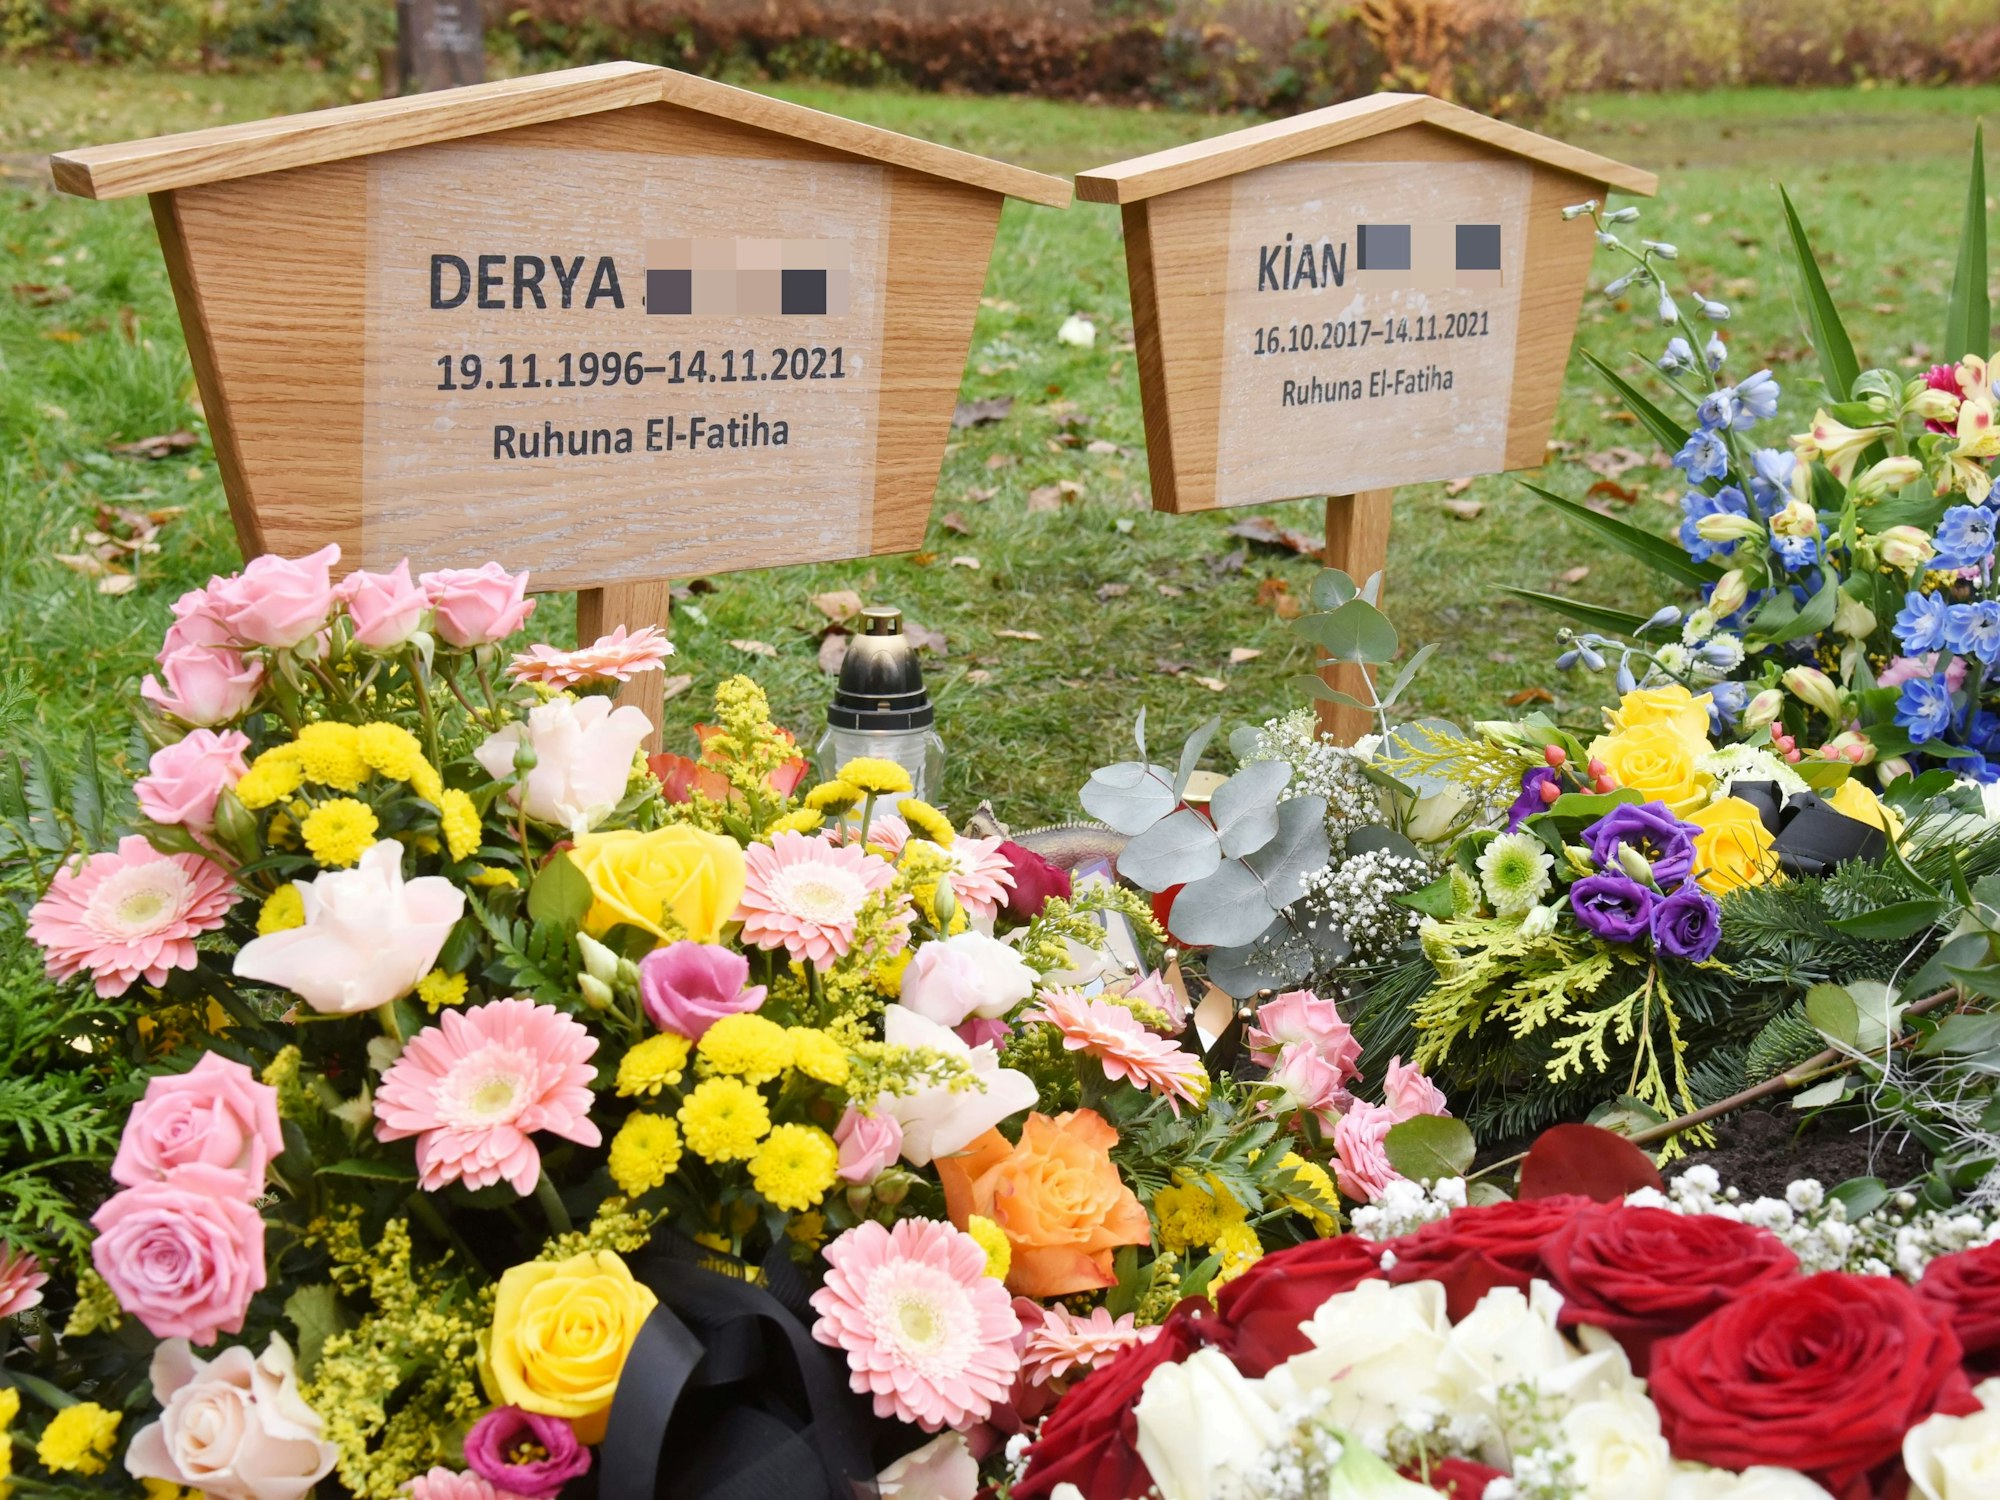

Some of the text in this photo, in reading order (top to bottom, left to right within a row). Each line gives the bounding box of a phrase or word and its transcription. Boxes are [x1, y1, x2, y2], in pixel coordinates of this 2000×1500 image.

[430, 254, 625, 310] DERYA
[1258, 232, 1347, 292] KİAN
[1282, 364, 1453, 407] Ruhuna El-Fatiha
[493, 413, 789, 460] Ruhuna El-Fatiha
